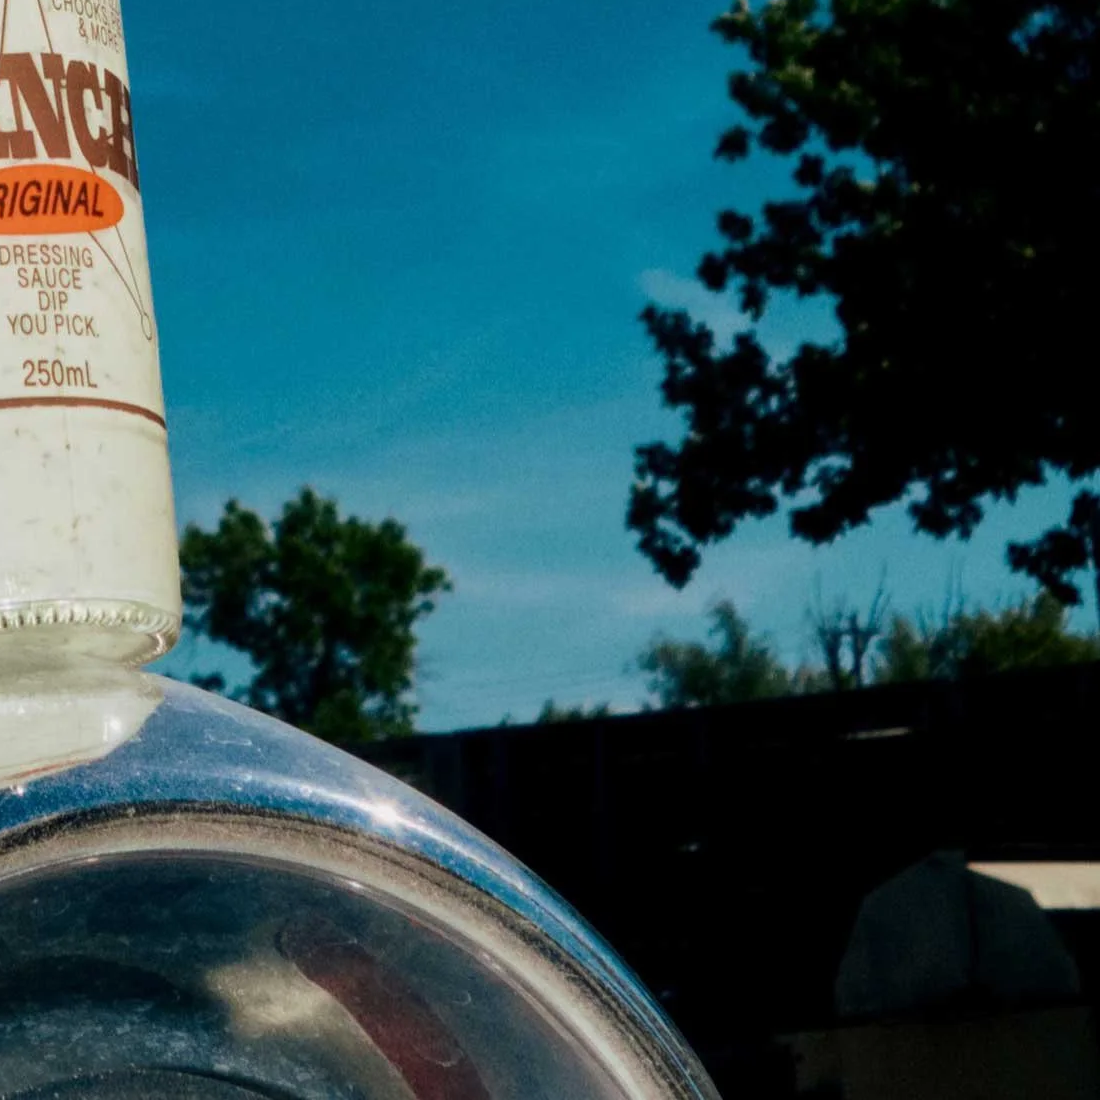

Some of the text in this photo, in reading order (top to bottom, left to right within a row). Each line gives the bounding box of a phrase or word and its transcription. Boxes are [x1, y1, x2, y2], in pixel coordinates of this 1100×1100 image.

[79, 17, 89, 44] &
[17, 267, 83, 289] SAUCE
[38, 291, 69, 311] DIP
[7, 313, 100, 338] YOU PICK.
[22, 359, 98, 389] 250mL
